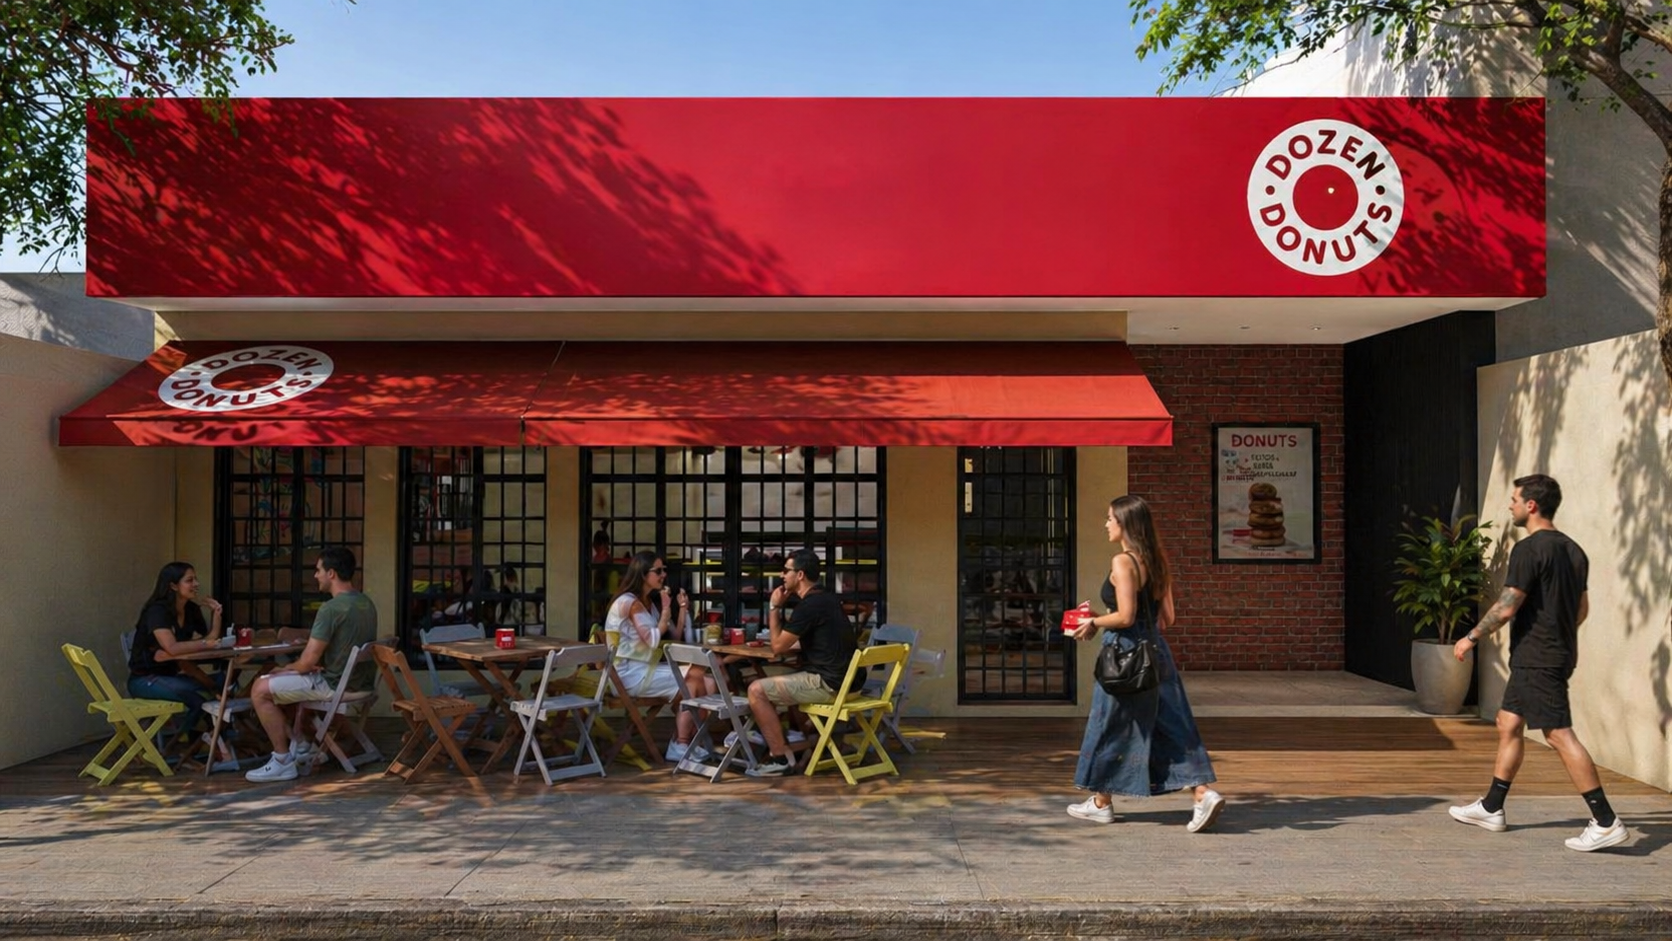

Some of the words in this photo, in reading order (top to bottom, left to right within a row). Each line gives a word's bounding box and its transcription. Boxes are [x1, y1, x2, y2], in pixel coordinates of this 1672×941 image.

[1265, 129, 1386, 180] DOZEN
[1259, 202, 1393, 265] DONUTS
[200, 349, 322, 372] DOZEN
[170, 377, 312, 408] DONUTS
[1231, 434, 1298, 448] DONUTS
